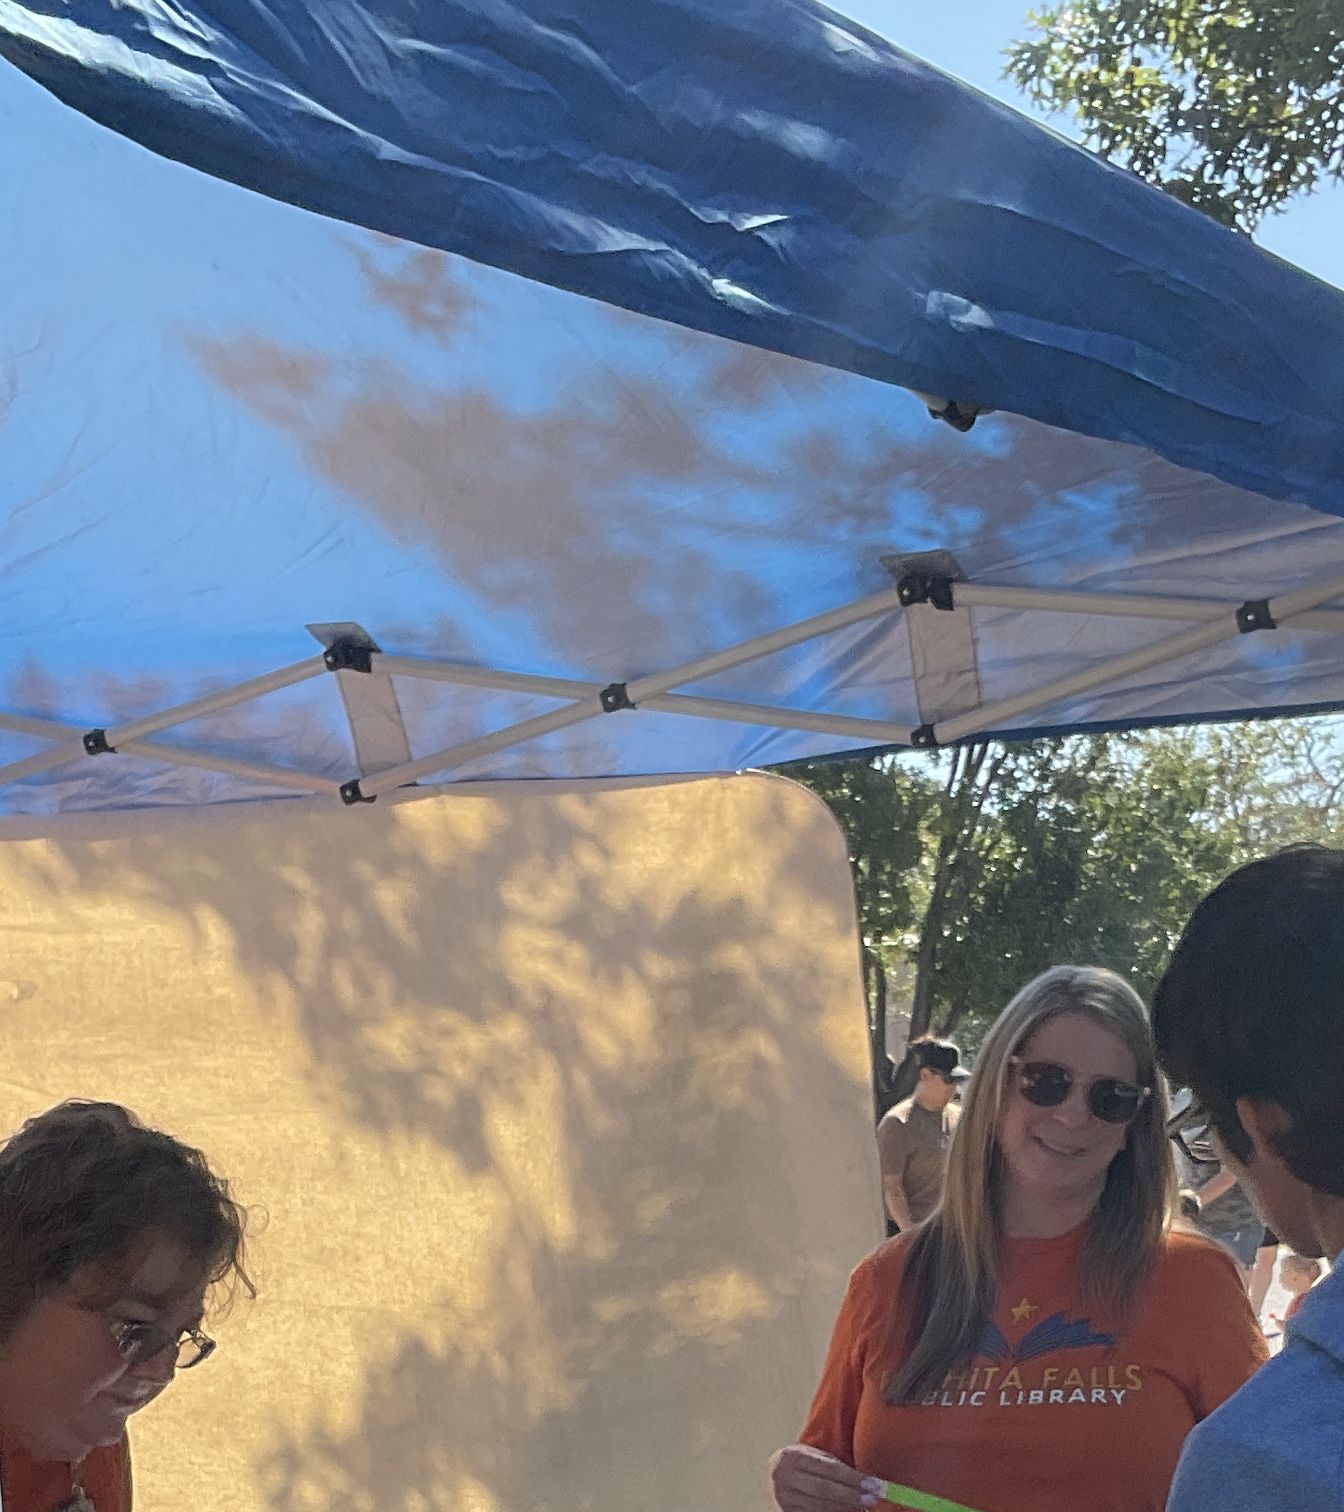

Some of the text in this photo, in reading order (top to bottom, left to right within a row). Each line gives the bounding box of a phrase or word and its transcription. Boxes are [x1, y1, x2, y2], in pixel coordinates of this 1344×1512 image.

[880, 1364, 1144, 1392] HITA FALLS
[920, 1388, 1128, 1407] BLIC LIBRARY
